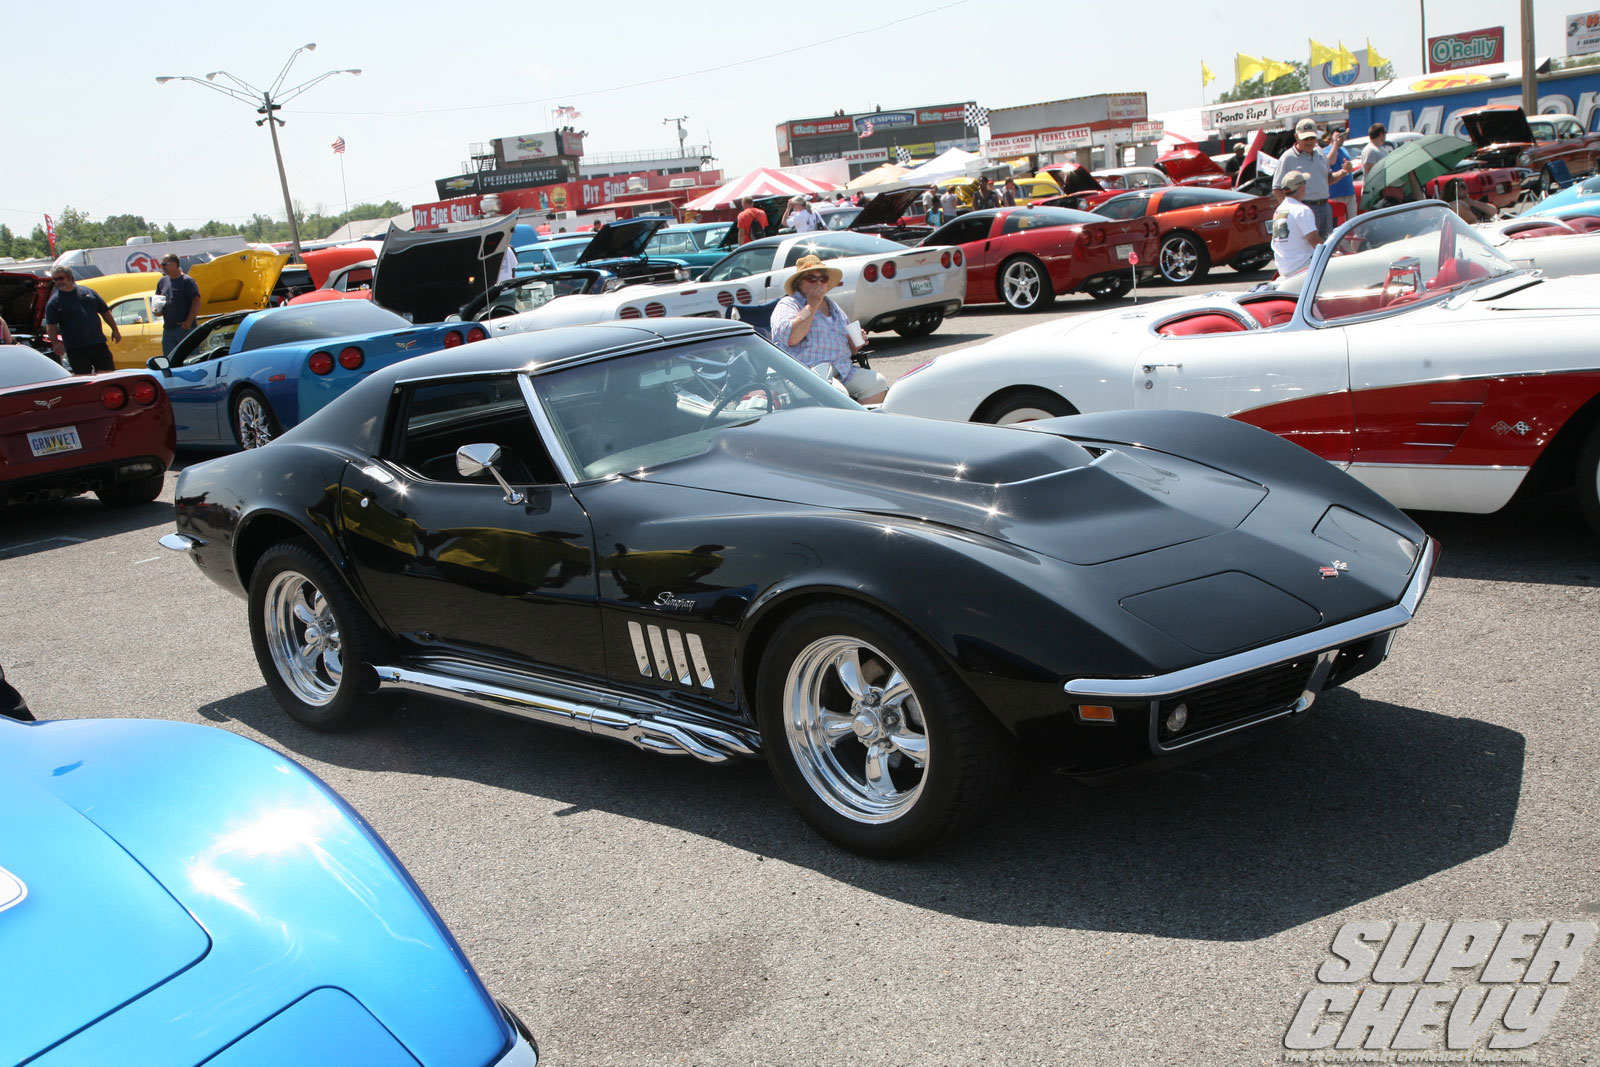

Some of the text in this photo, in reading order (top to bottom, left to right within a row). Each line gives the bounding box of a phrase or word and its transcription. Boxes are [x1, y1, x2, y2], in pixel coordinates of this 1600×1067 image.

[1433, 37, 1497, 63] O'Reilly
[1313, 96, 1330, 108] Pronto
[1215, 107, 1268, 123] Pronto Pups
[1012, 136, 1032, 144] CAKES
[1041, 129, 1089, 142] FUNNEL CAKES
[483, 169, 558, 187] PERFORMANCE
[583, 183, 600, 206] PIT
[415, 203, 475, 227] PIT SIDE GRILL
[32, 432, 76, 450] GRNYVET
[653, 591, 696, 612] Stingray
